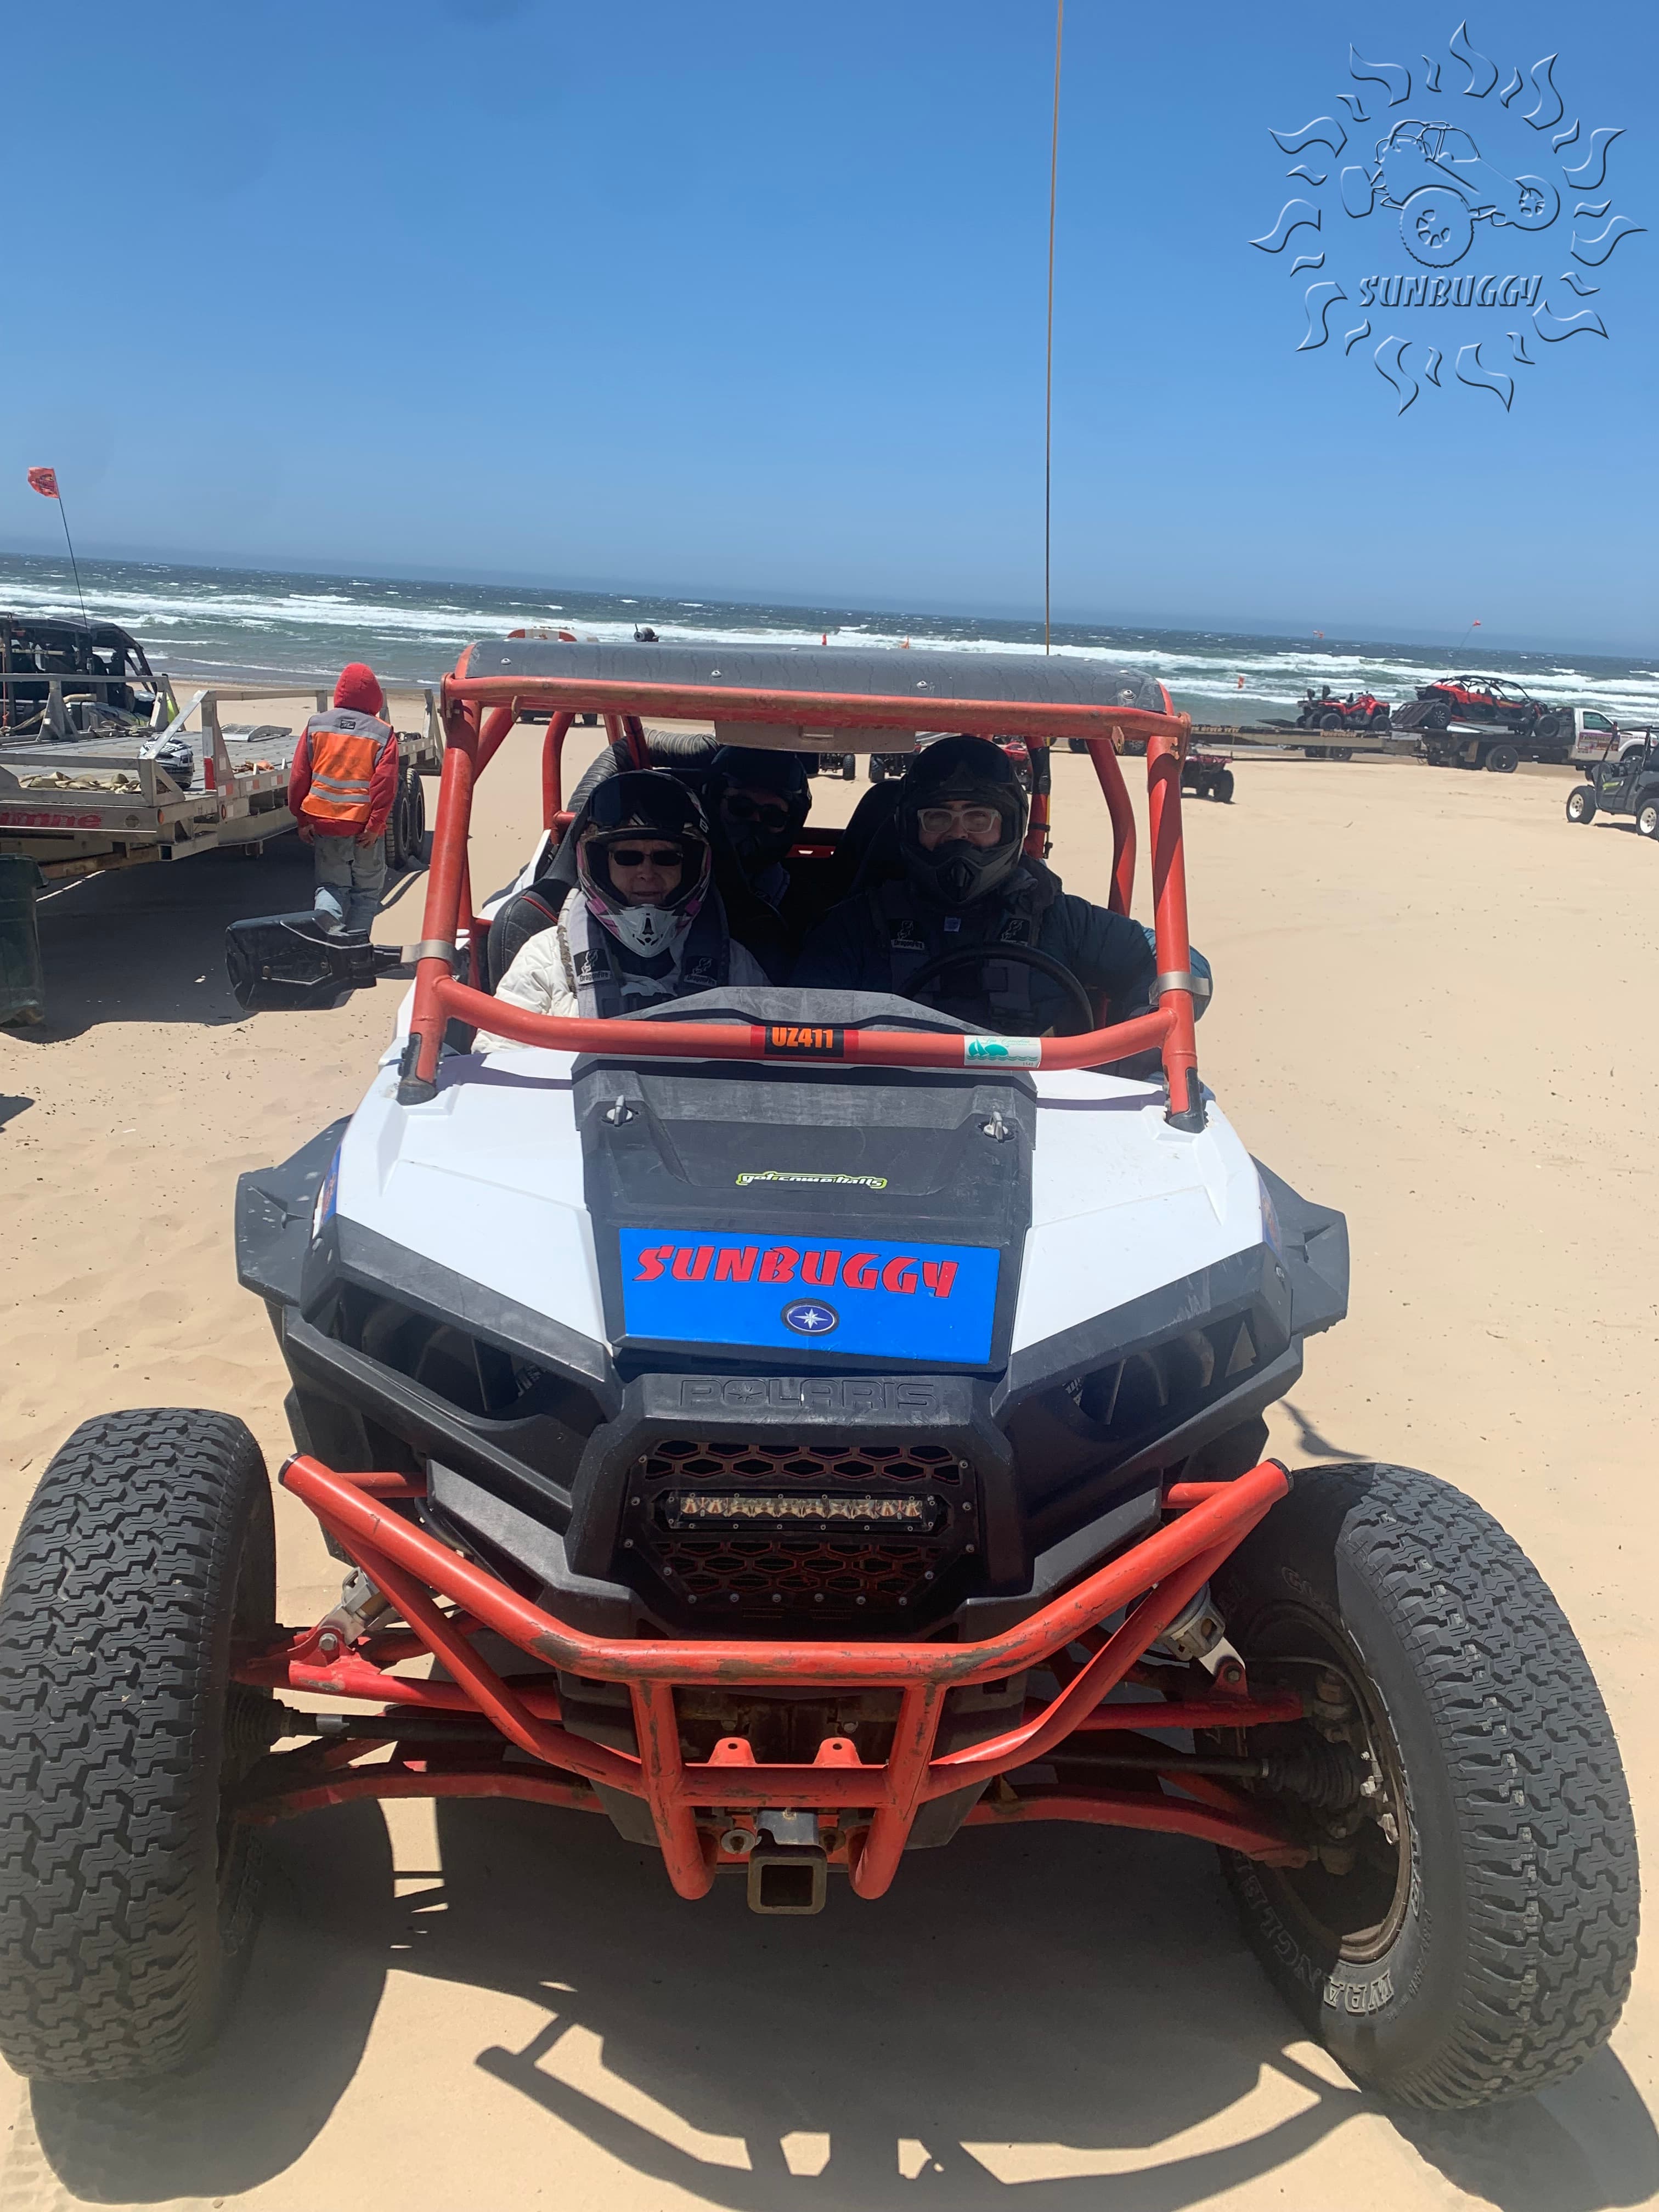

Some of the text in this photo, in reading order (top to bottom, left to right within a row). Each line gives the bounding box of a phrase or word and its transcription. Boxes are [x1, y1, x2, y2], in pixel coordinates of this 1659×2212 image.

[772, 1026, 833, 1048] UZ411
[632, 1245, 959, 1299] SUNBUGGY
[679, 1378, 939, 1410] POLARIS
